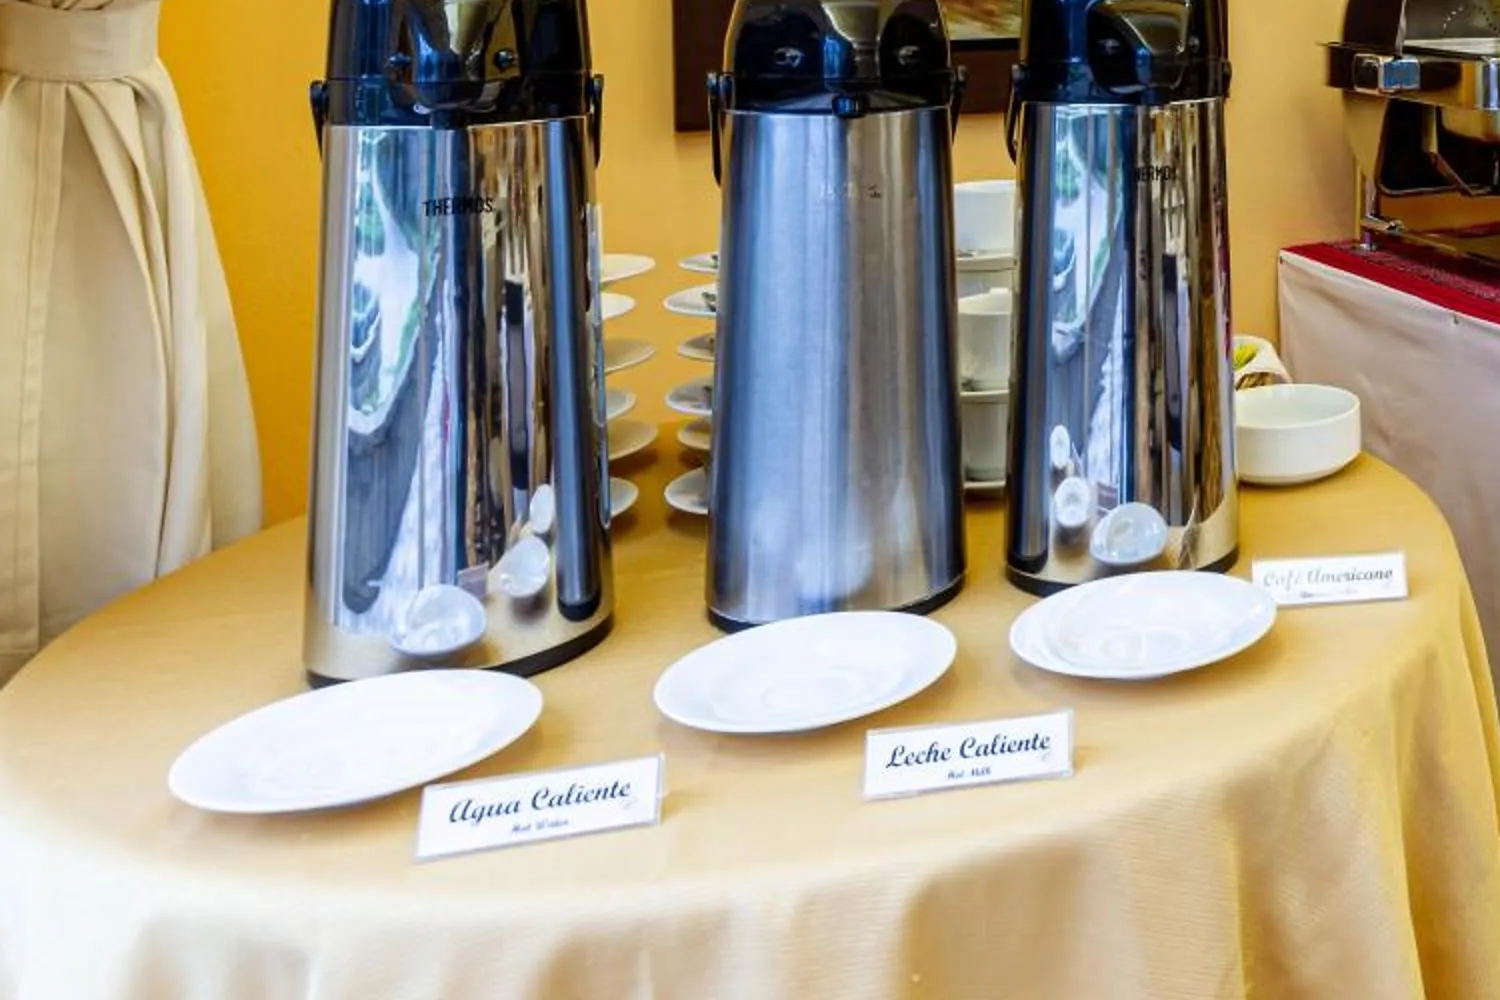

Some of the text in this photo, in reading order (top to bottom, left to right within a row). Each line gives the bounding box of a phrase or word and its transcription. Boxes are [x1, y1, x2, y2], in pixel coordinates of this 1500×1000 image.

[1307, 566, 1394, 585] Americano
[886, 732, 1051, 769] Leche Caliente
[448, 780, 632, 826] Agua Caliente
